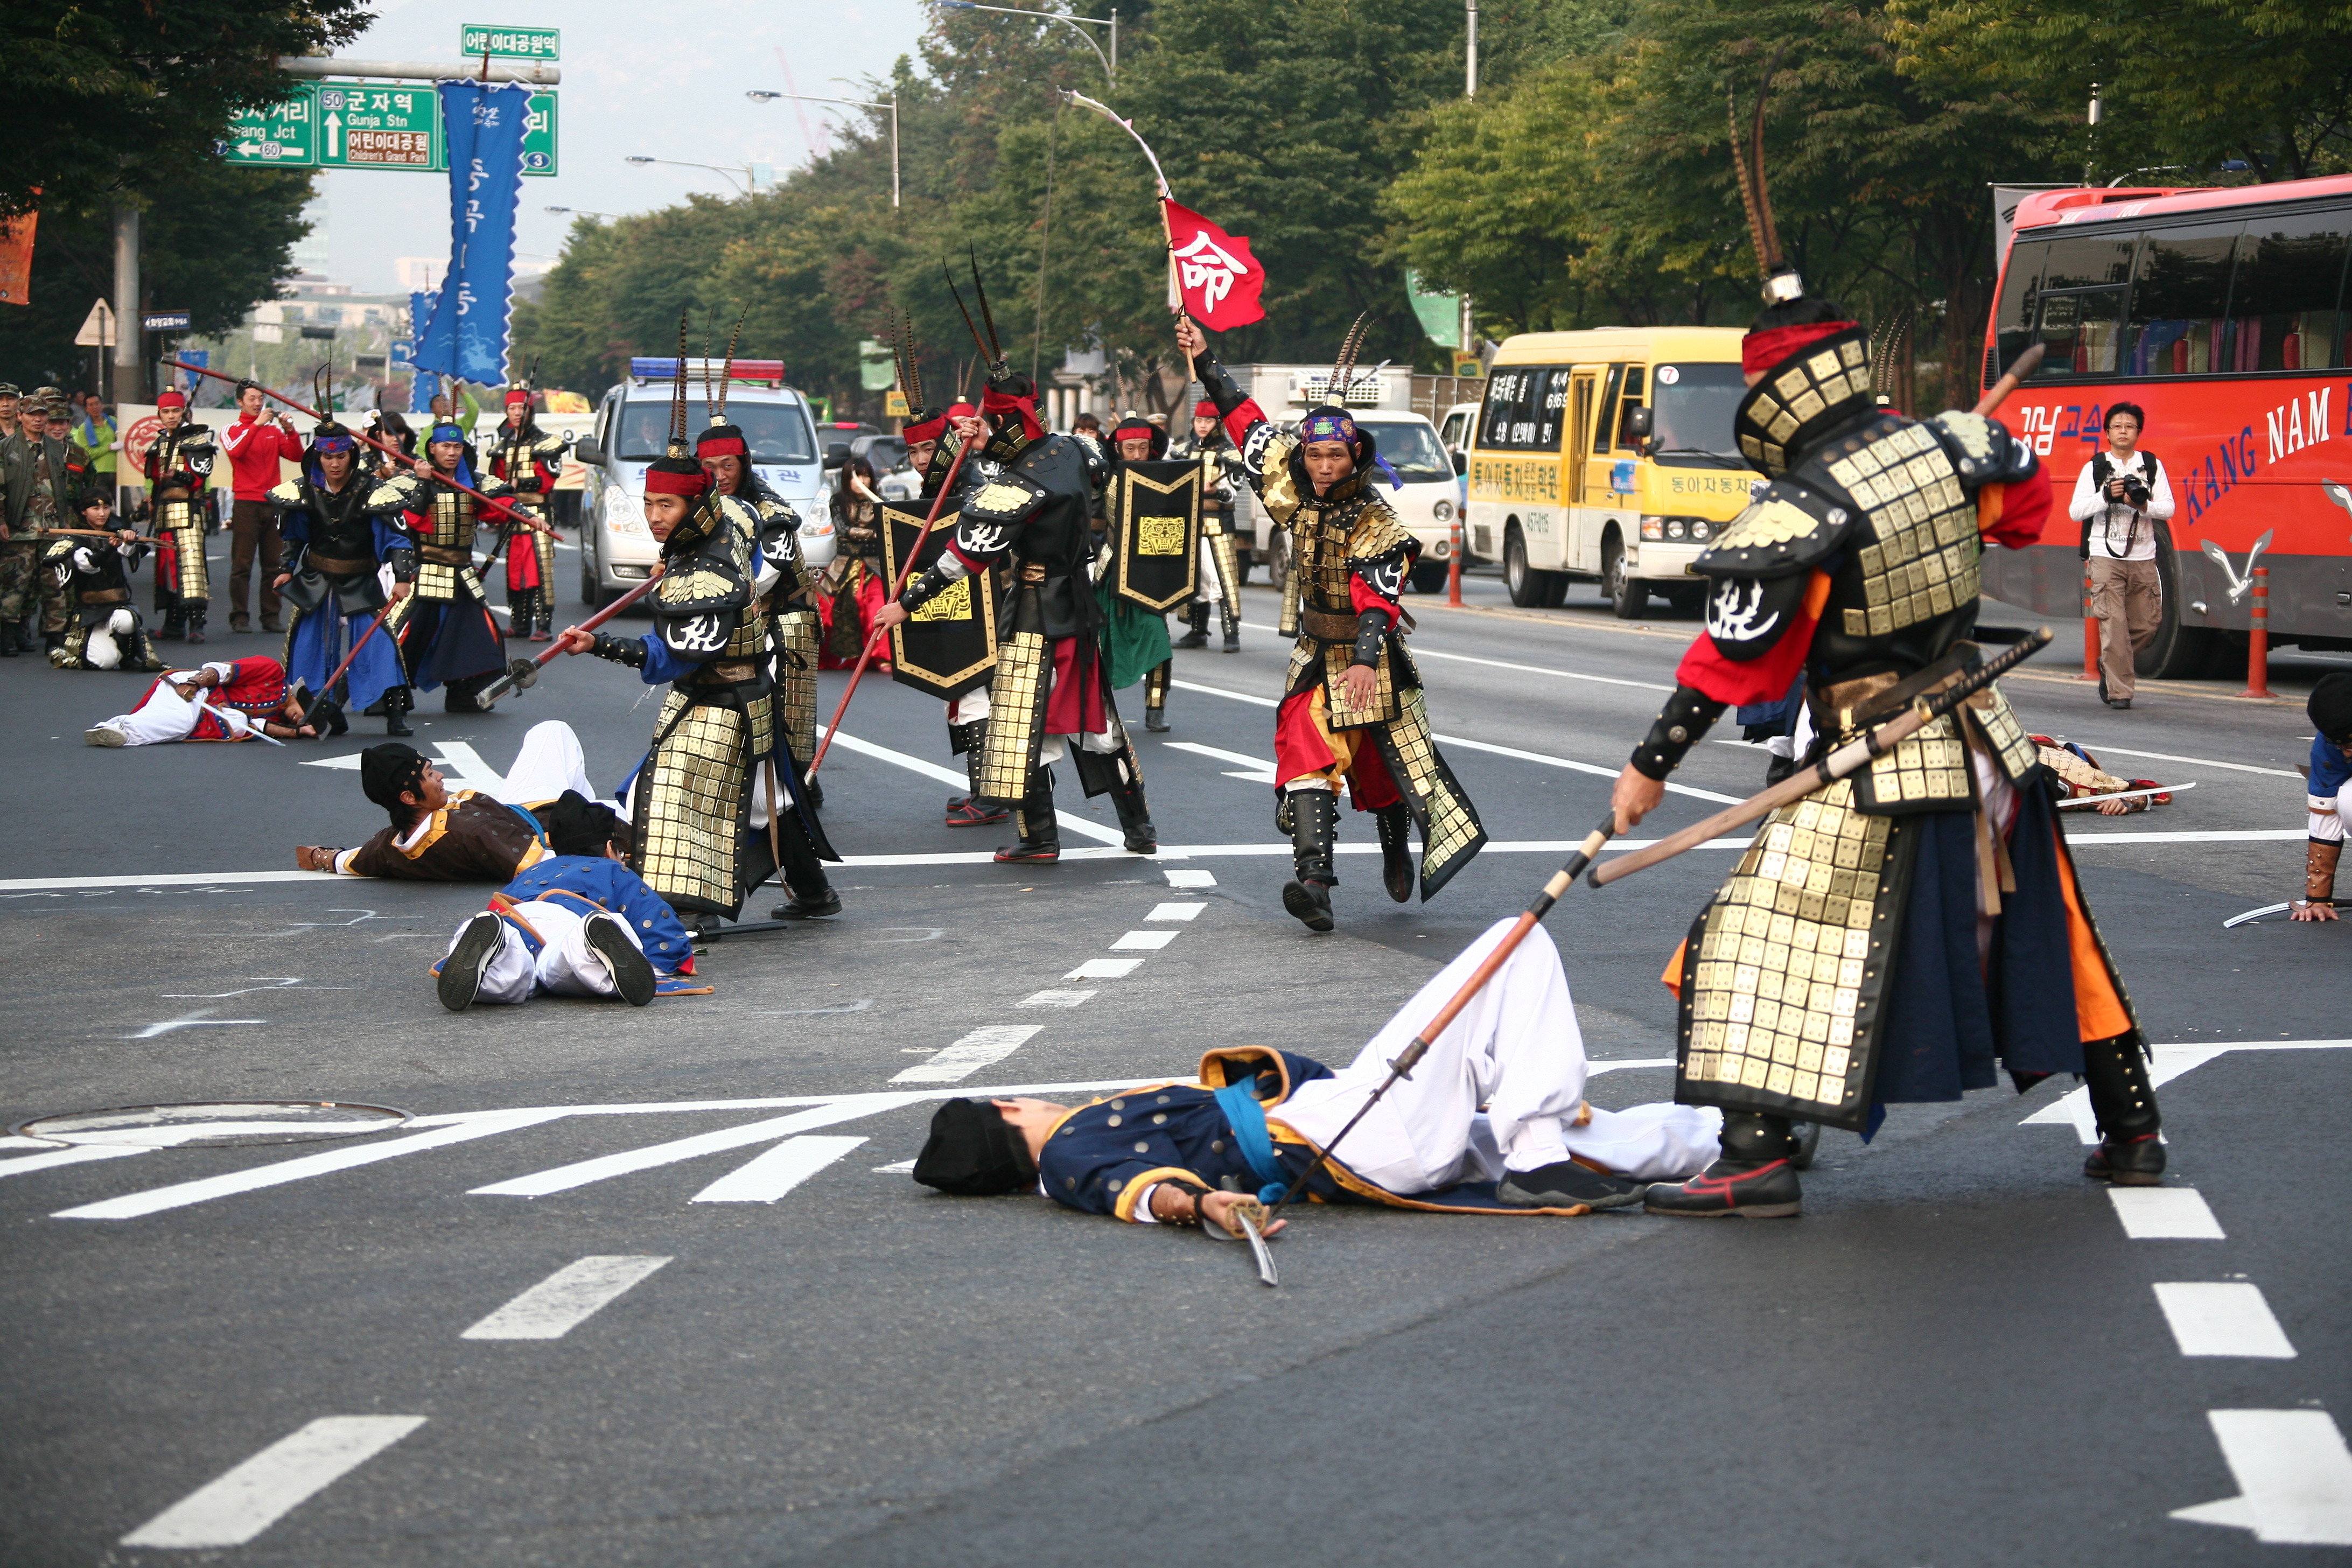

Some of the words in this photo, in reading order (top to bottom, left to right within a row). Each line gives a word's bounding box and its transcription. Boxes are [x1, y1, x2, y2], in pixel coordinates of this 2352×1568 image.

[466, 31, 556, 53] 어린이대공원역
[324, 94, 341, 106] 50
[347, 113, 381, 129] Gunja
[387, 114, 408, 127] Stn
[274, 124, 296, 139] Jct
[349, 131, 427, 151] 어린이대공원
[264, 144, 278, 156] 60
[350, 149, 384, 161] Children's
[386, 151, 407, 162] Grand
[410, 152, 426, 162] Park
[534, 155, 543, 166] 3
[1173, 230, 1248, 314] 命
[1663, 368, 1675, 382] 7
[2183, 424, 2256, 526] KANG
[2266, 386, 2331, 465] NAM
[1672, 477, 1763, 494] 동아자동차
